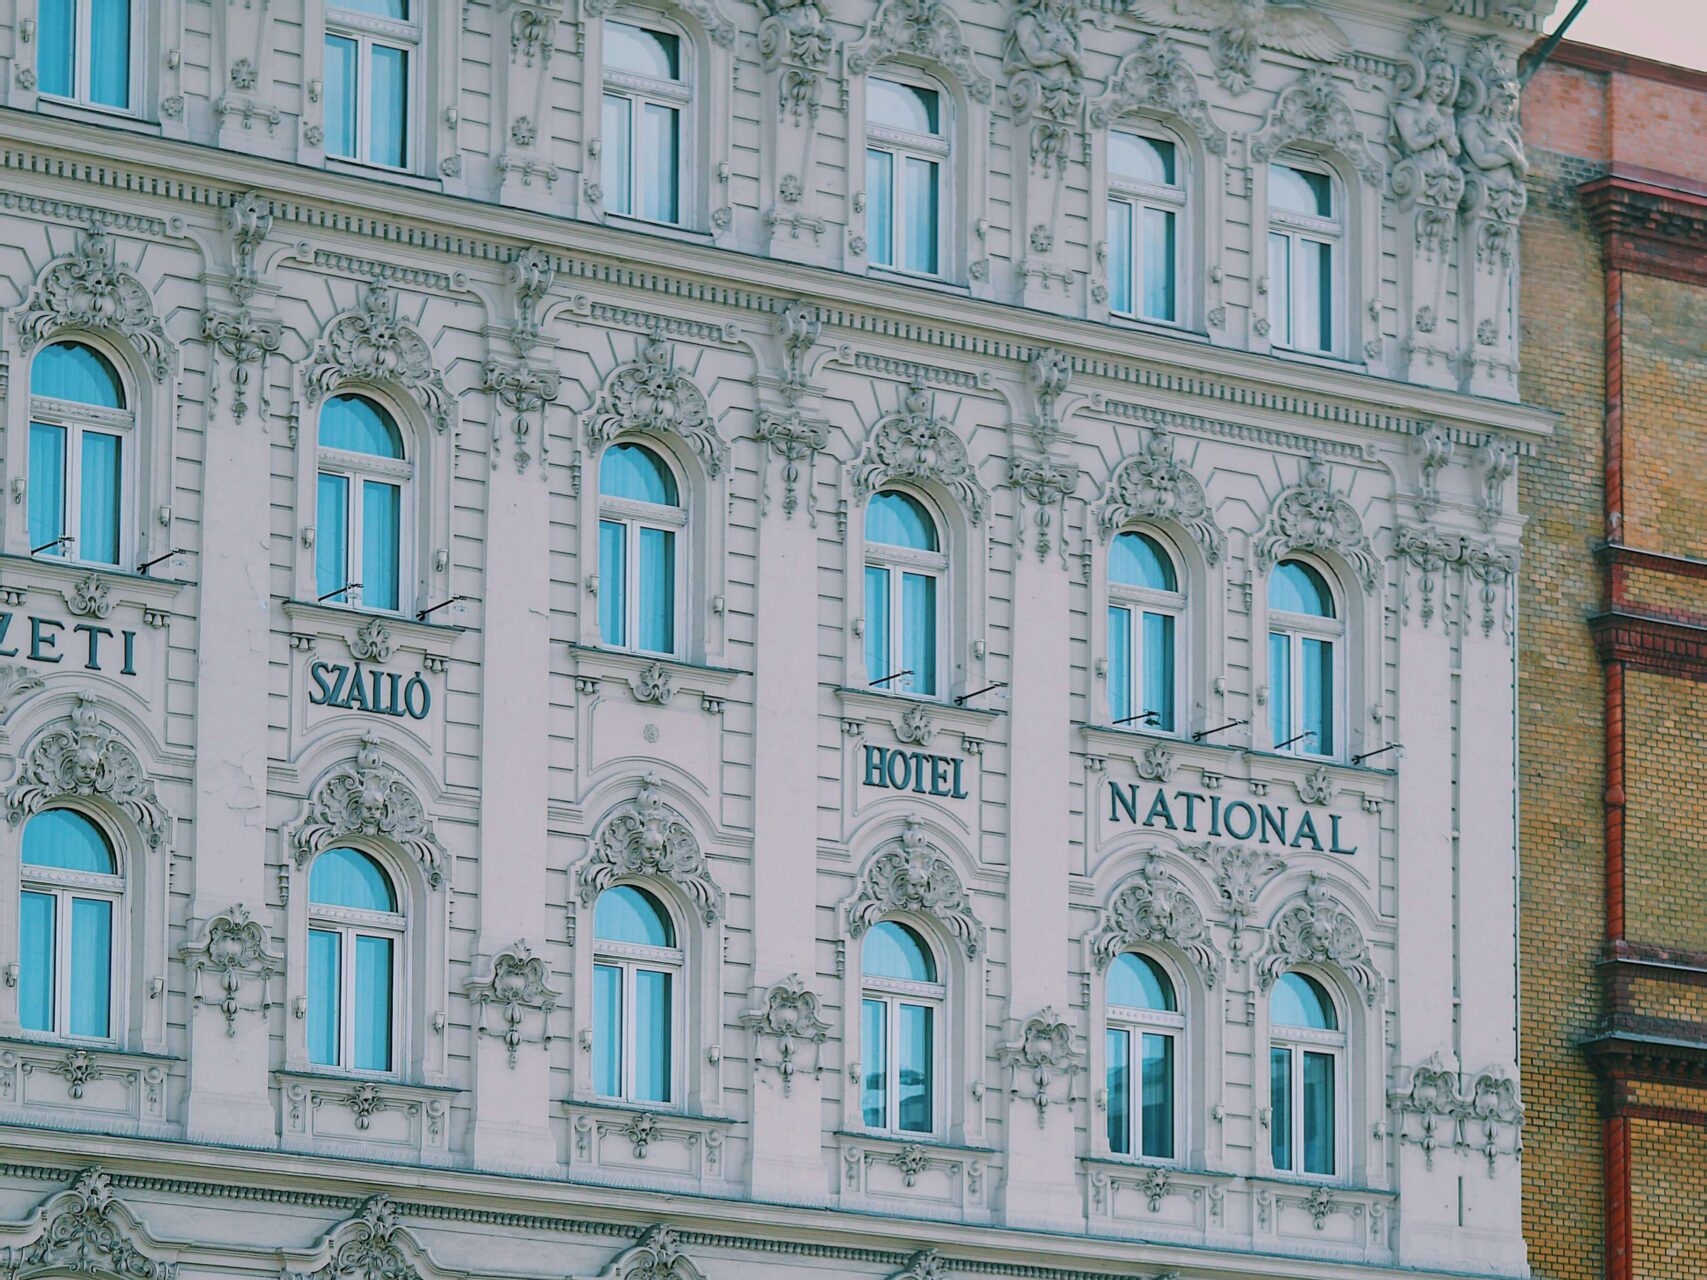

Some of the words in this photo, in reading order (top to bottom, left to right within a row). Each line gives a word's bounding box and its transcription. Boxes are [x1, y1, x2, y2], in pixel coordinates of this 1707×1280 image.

[308, 660, 431, 720] SZÁLLÓ
[863, 744, 969, 800] HOTEL
[1108, 781, 1358, 855] NATIONAL
